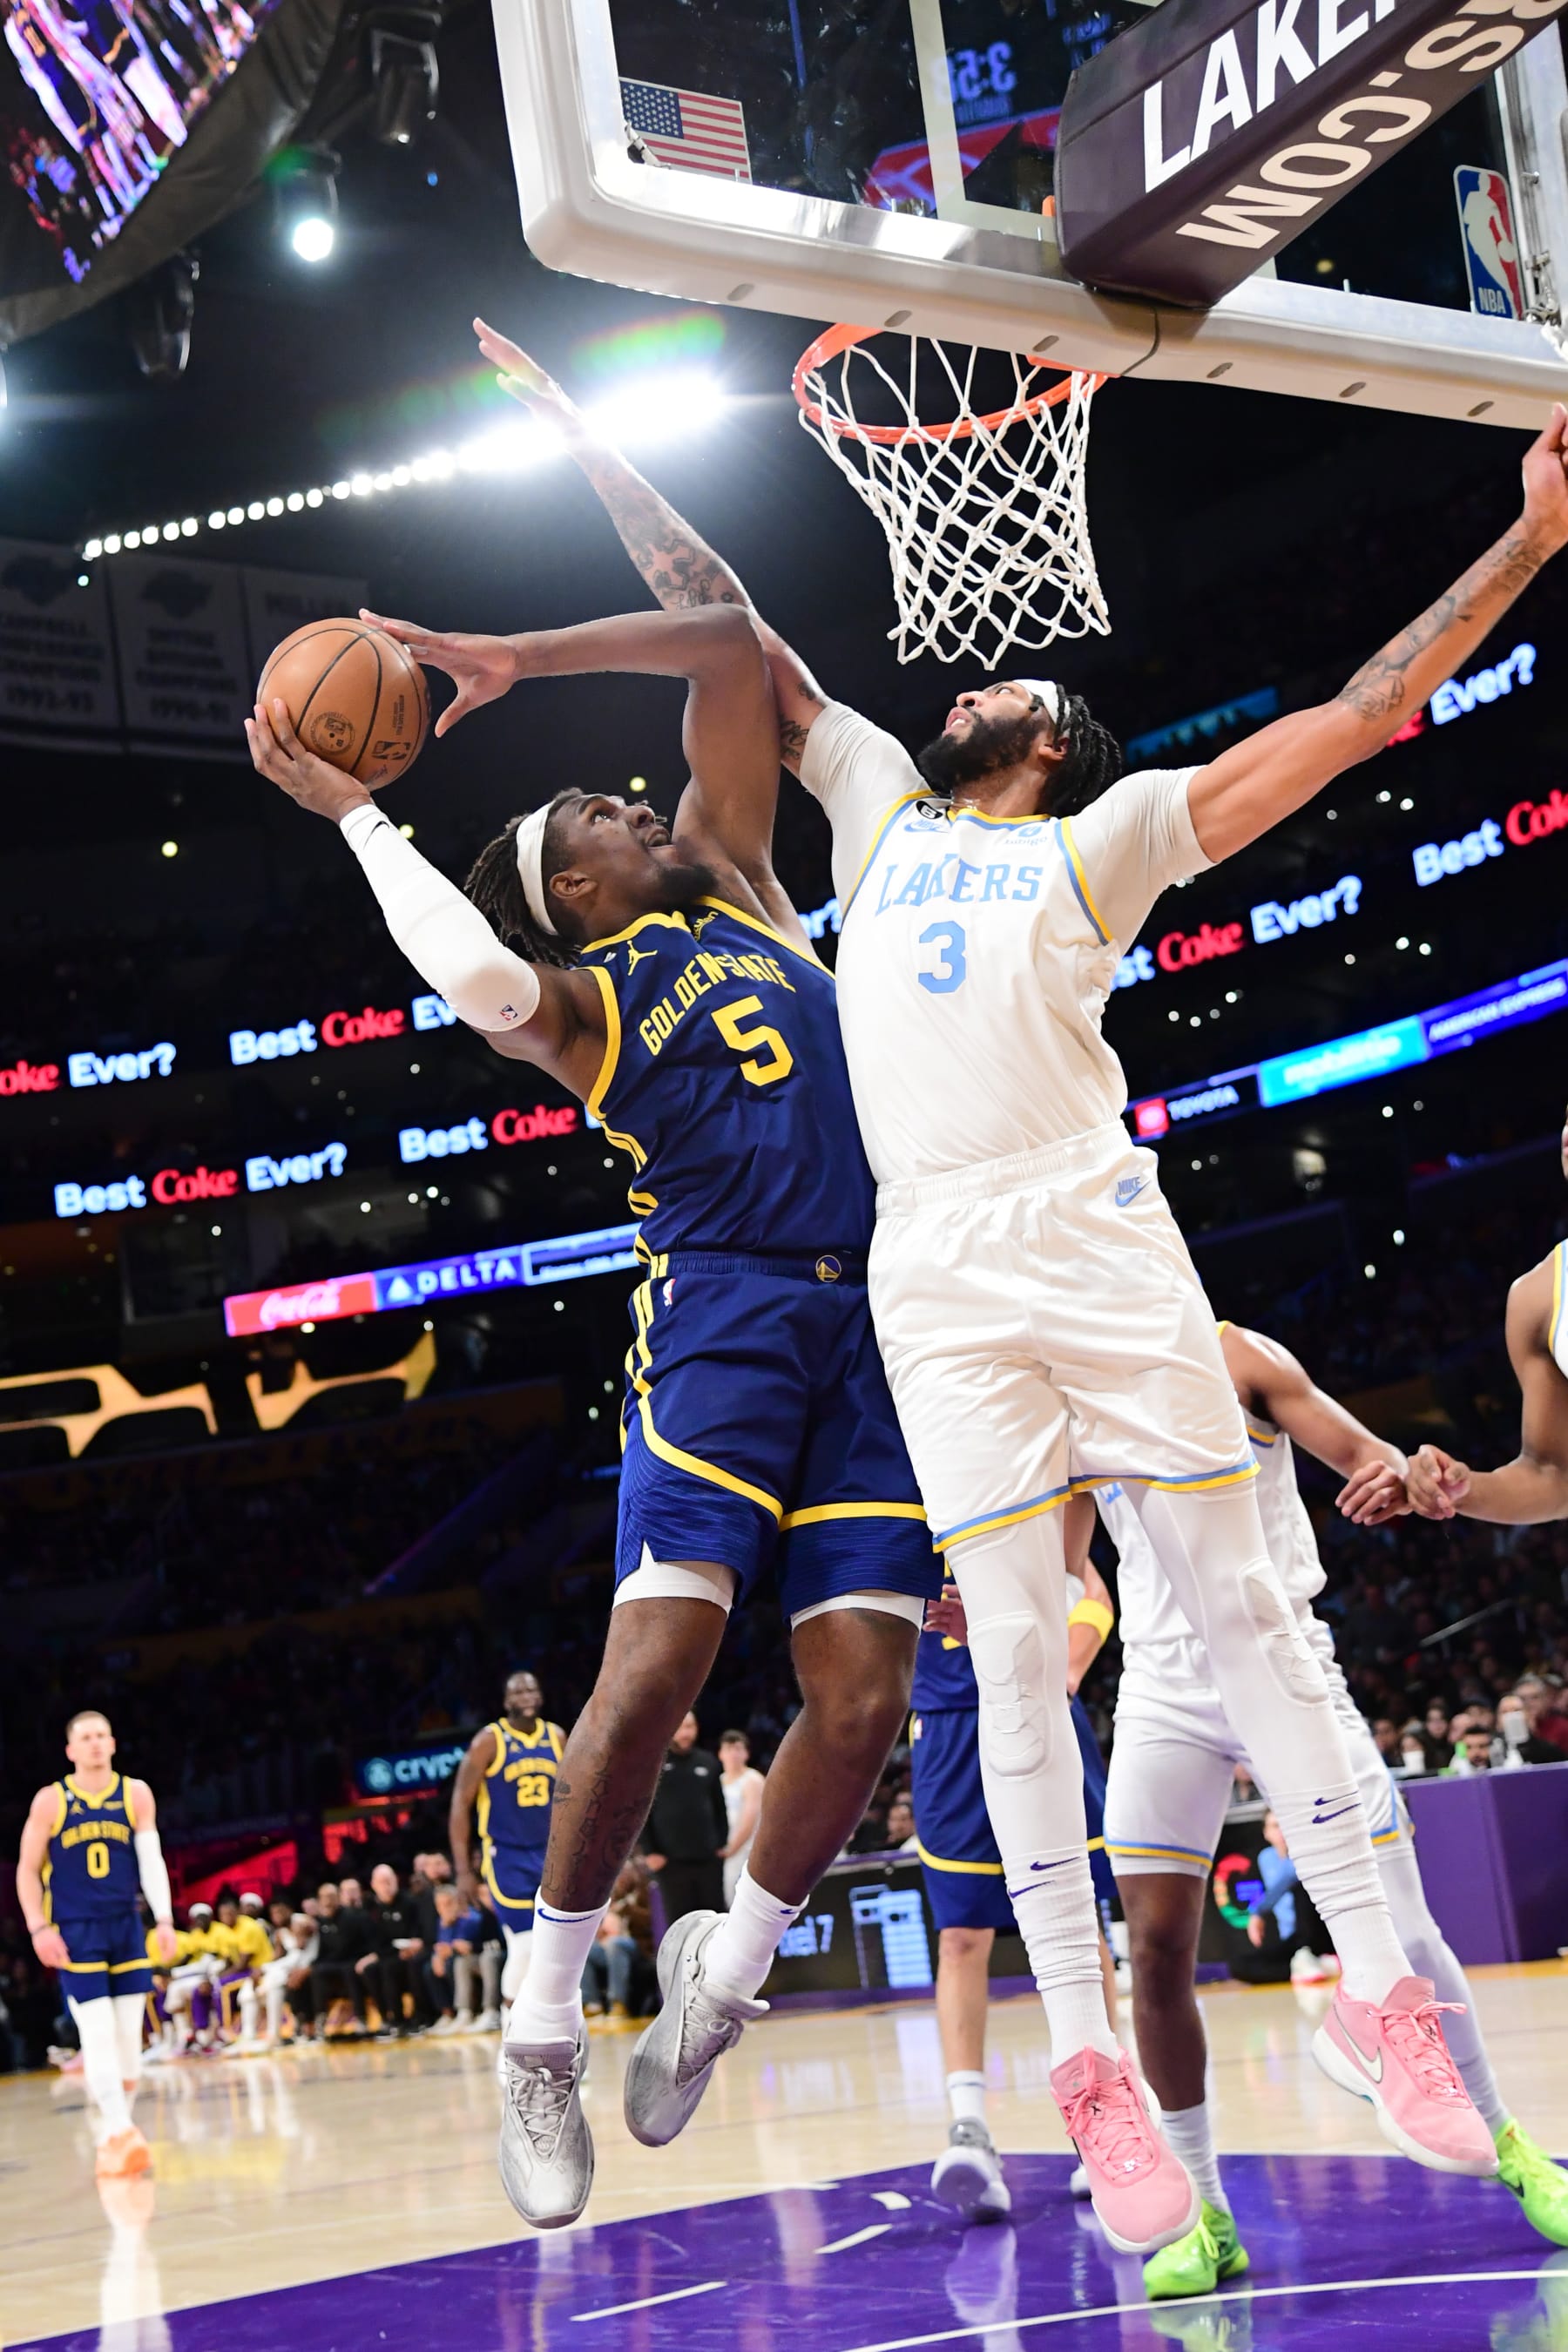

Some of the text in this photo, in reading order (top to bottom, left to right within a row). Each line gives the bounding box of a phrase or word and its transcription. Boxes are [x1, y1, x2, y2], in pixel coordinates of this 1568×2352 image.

[1144, 0, 1396, 193] LAKE
[1477, 286, 1507, 314] NBA
[1429, 643, 1537, 725] Ever?
[875, 854, 1044, 916] LAKERS
[1411, 818, 1504, 887] Best
[918, 921, 966, 993] 3
[1110, 875, 1362, 991] st Coke Ever?
[229, 1019, 317, 1065] Best
[321, 1006, 406, 1047] Coke
[639, 952, 727, 1057] GOLDEN
[68, 1042, 177, 1088] Ever?
[710, 995, 794, 1086] 5
[399, 1117, 488, 1163] Best
[491, 1105, 578, 1145] Coke
[54, 1142, 348, 1218] Best Coke Ever?
[416, 1258, 517, 1295] DELTA
[517, 1775, 550, 1808] 23
[86, 1841, 111, 1879] 0
